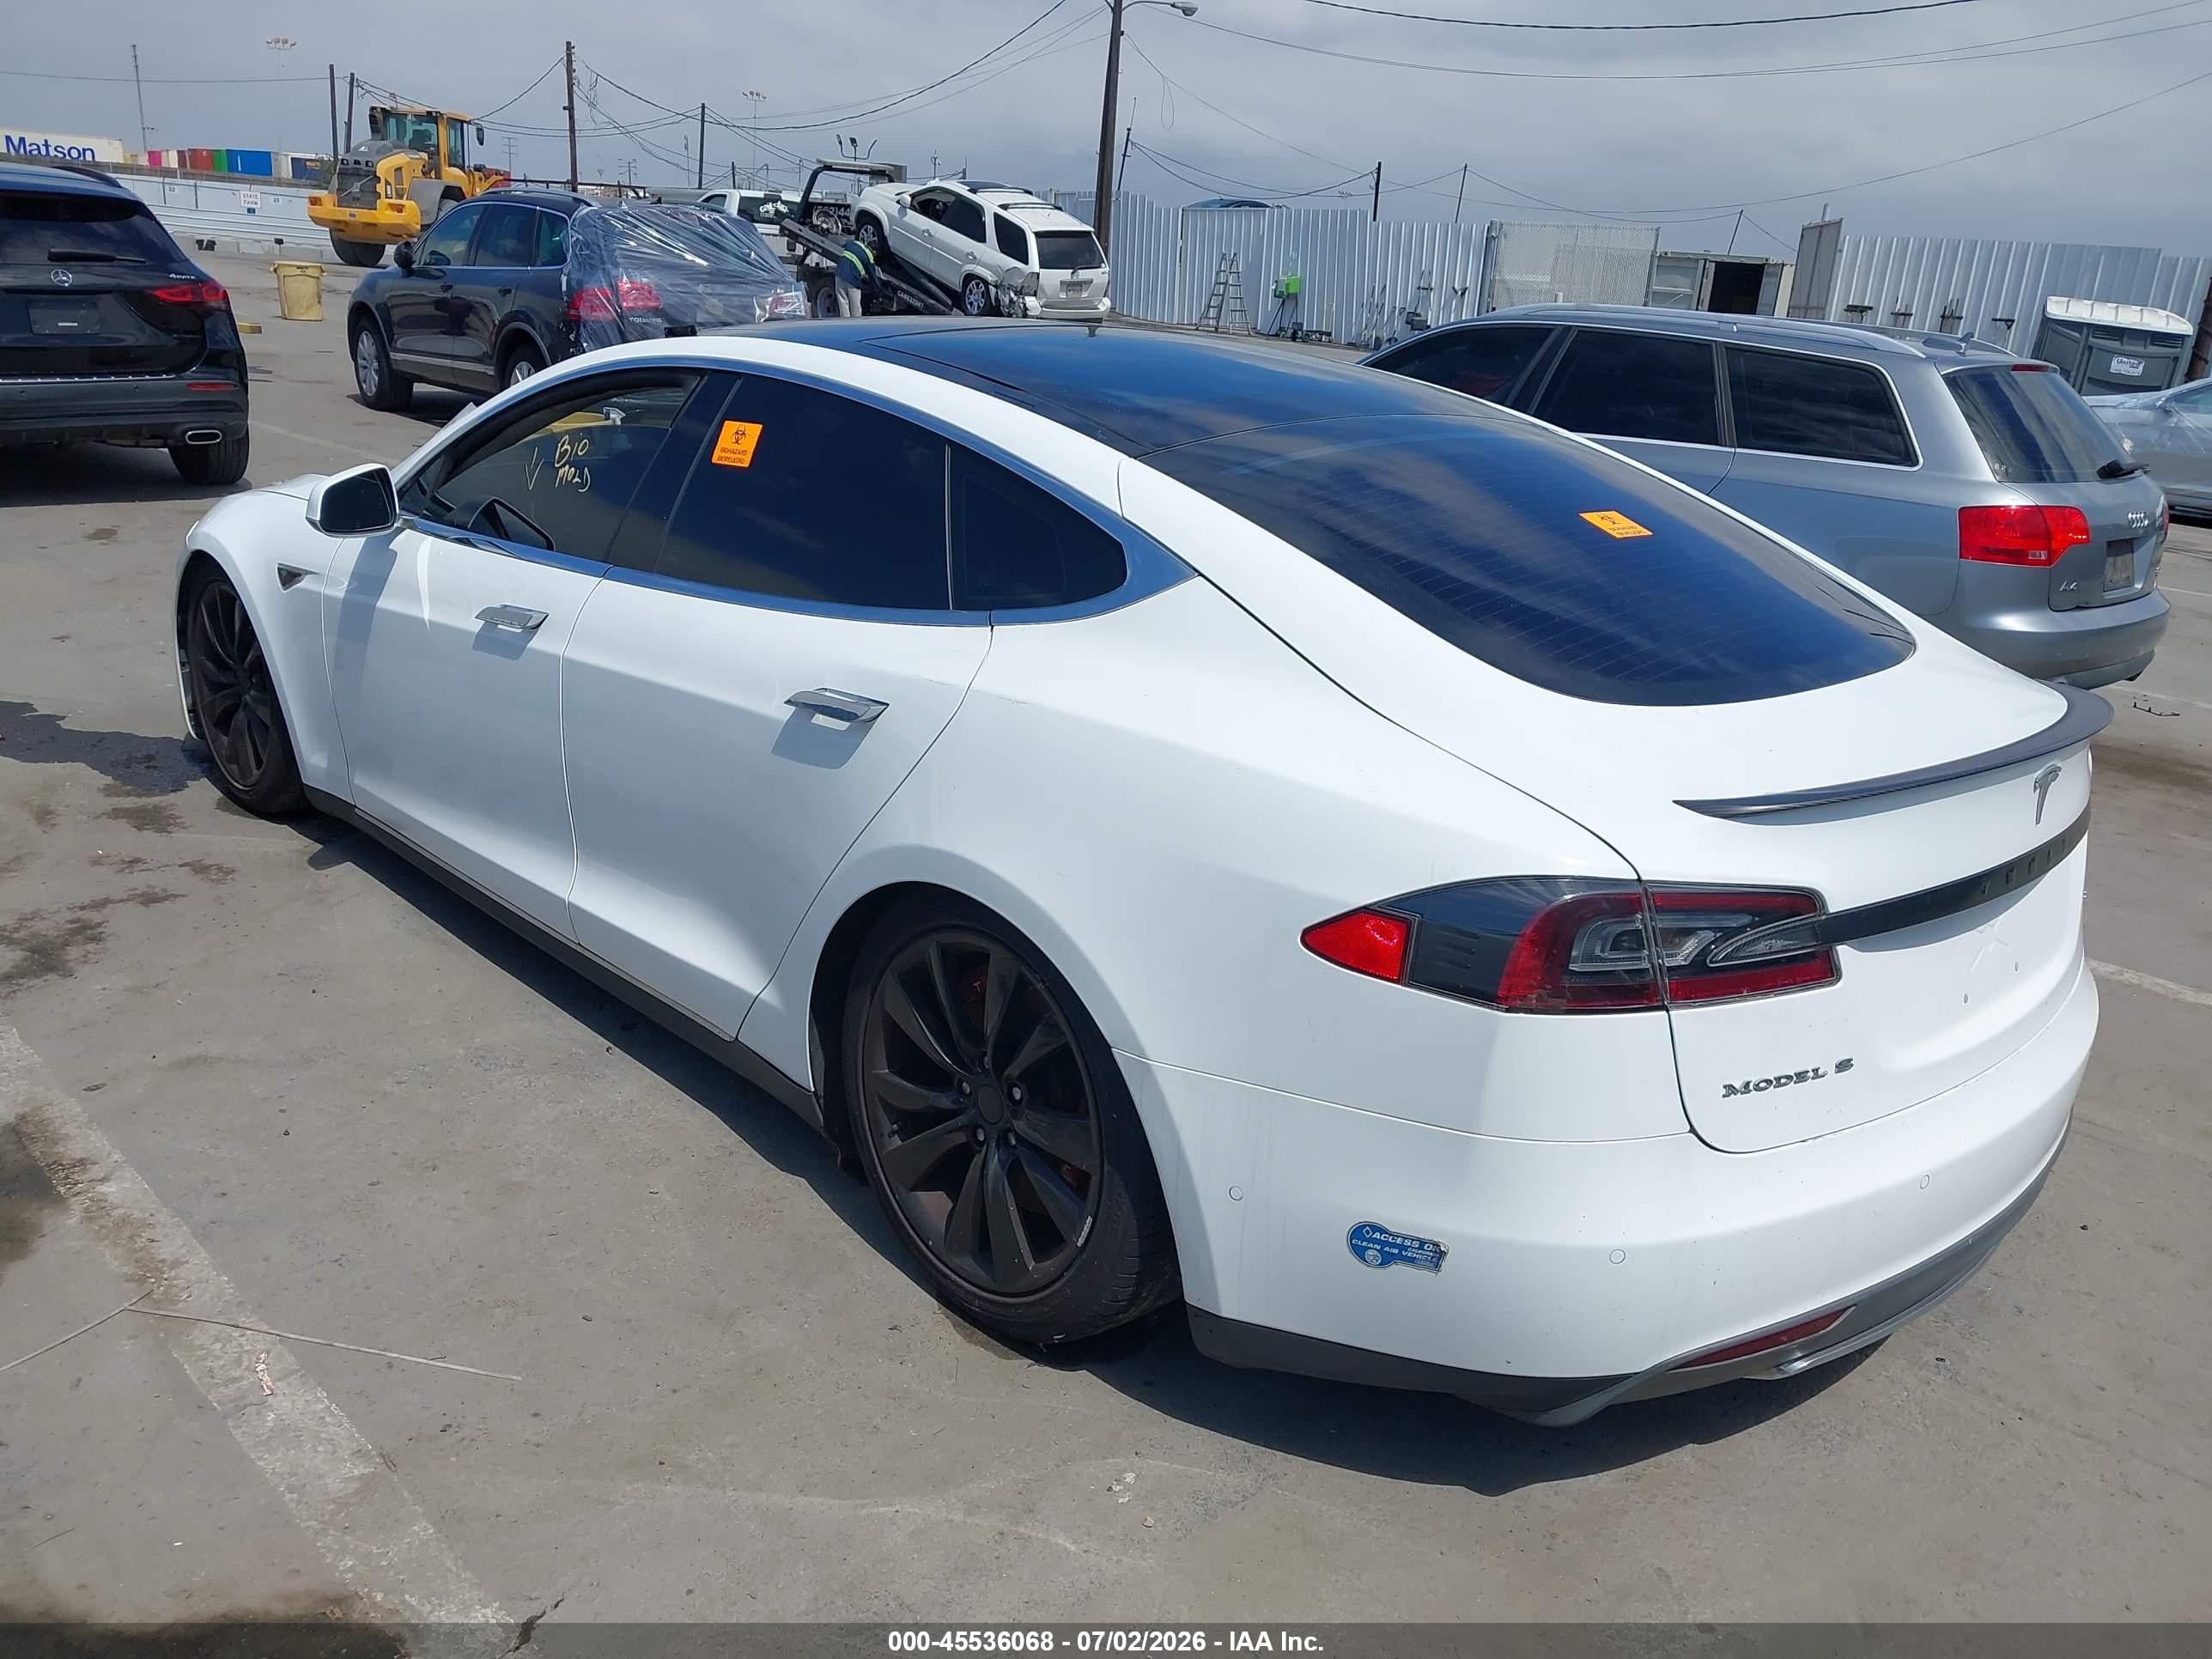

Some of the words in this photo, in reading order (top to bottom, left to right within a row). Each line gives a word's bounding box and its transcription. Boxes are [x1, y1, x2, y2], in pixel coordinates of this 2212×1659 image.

[4, 135, 95, 161] Matson
[720, 447, 748, 456] BIOHAZARD
[1721, 1066, 1829, 1099] MODEL
[1834, 1057, 1855, 1074] S
[1352, 1238, 1382, 1250] CLEAN
[1383, 1246, 1400, 1255] AIR
[1401, 1250, 1439, 1263] VEHICLE
[1372, 1231, 1420, 1249] ACCESS
